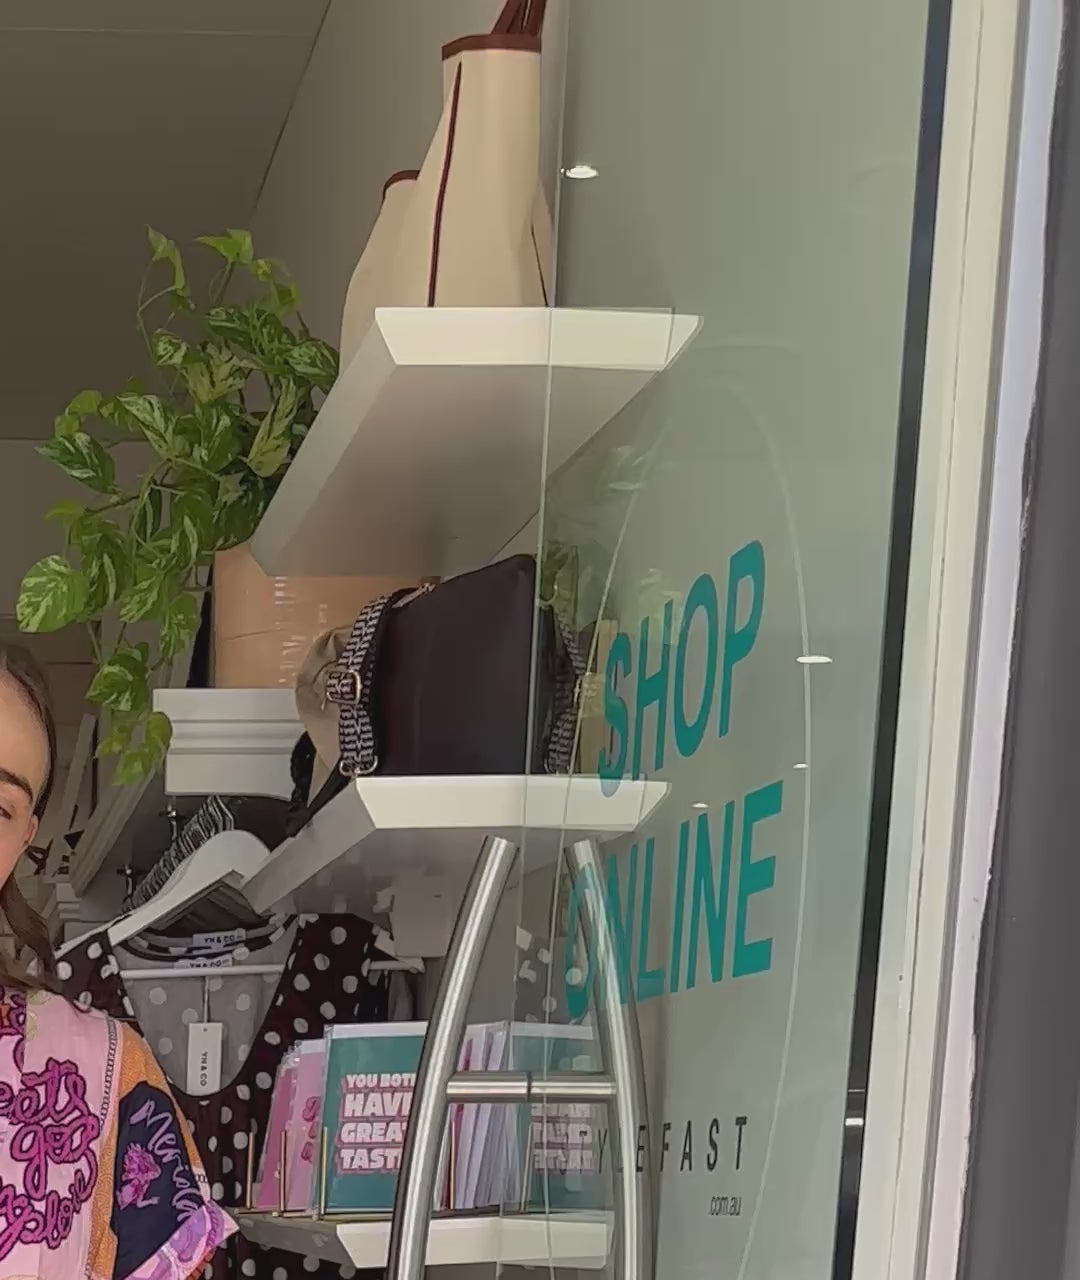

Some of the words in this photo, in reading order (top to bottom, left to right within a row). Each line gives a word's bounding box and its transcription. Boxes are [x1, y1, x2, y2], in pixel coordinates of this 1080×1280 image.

[598, 540, 766, 797] SHOP
[565, 780, 783, 1018] ONLINE
[340, 1122, 407, 1143] GREA
[346, 1073, 378, 1088] YOU
